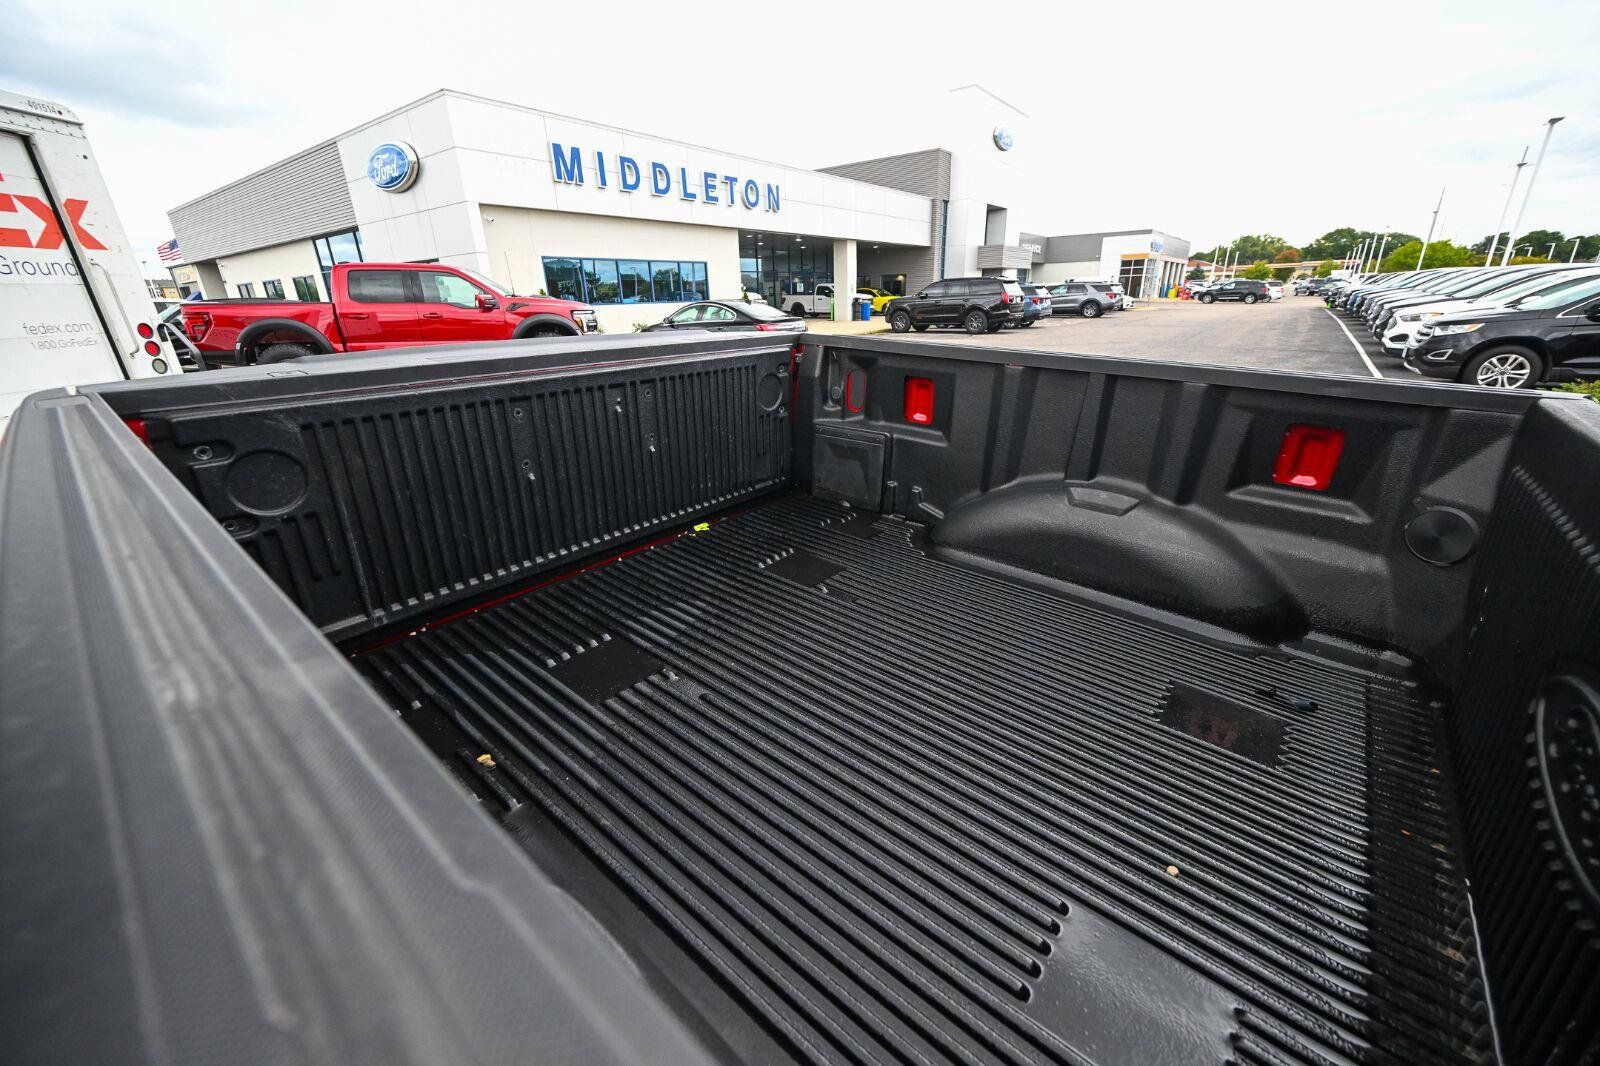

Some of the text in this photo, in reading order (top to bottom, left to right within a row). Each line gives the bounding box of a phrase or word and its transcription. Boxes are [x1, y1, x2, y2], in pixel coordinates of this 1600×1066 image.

[551, 142, 780, 213] MIDDLETON
[0, 255, 79, 276] Ground
[22, 322, 94, 335] fedex.com
